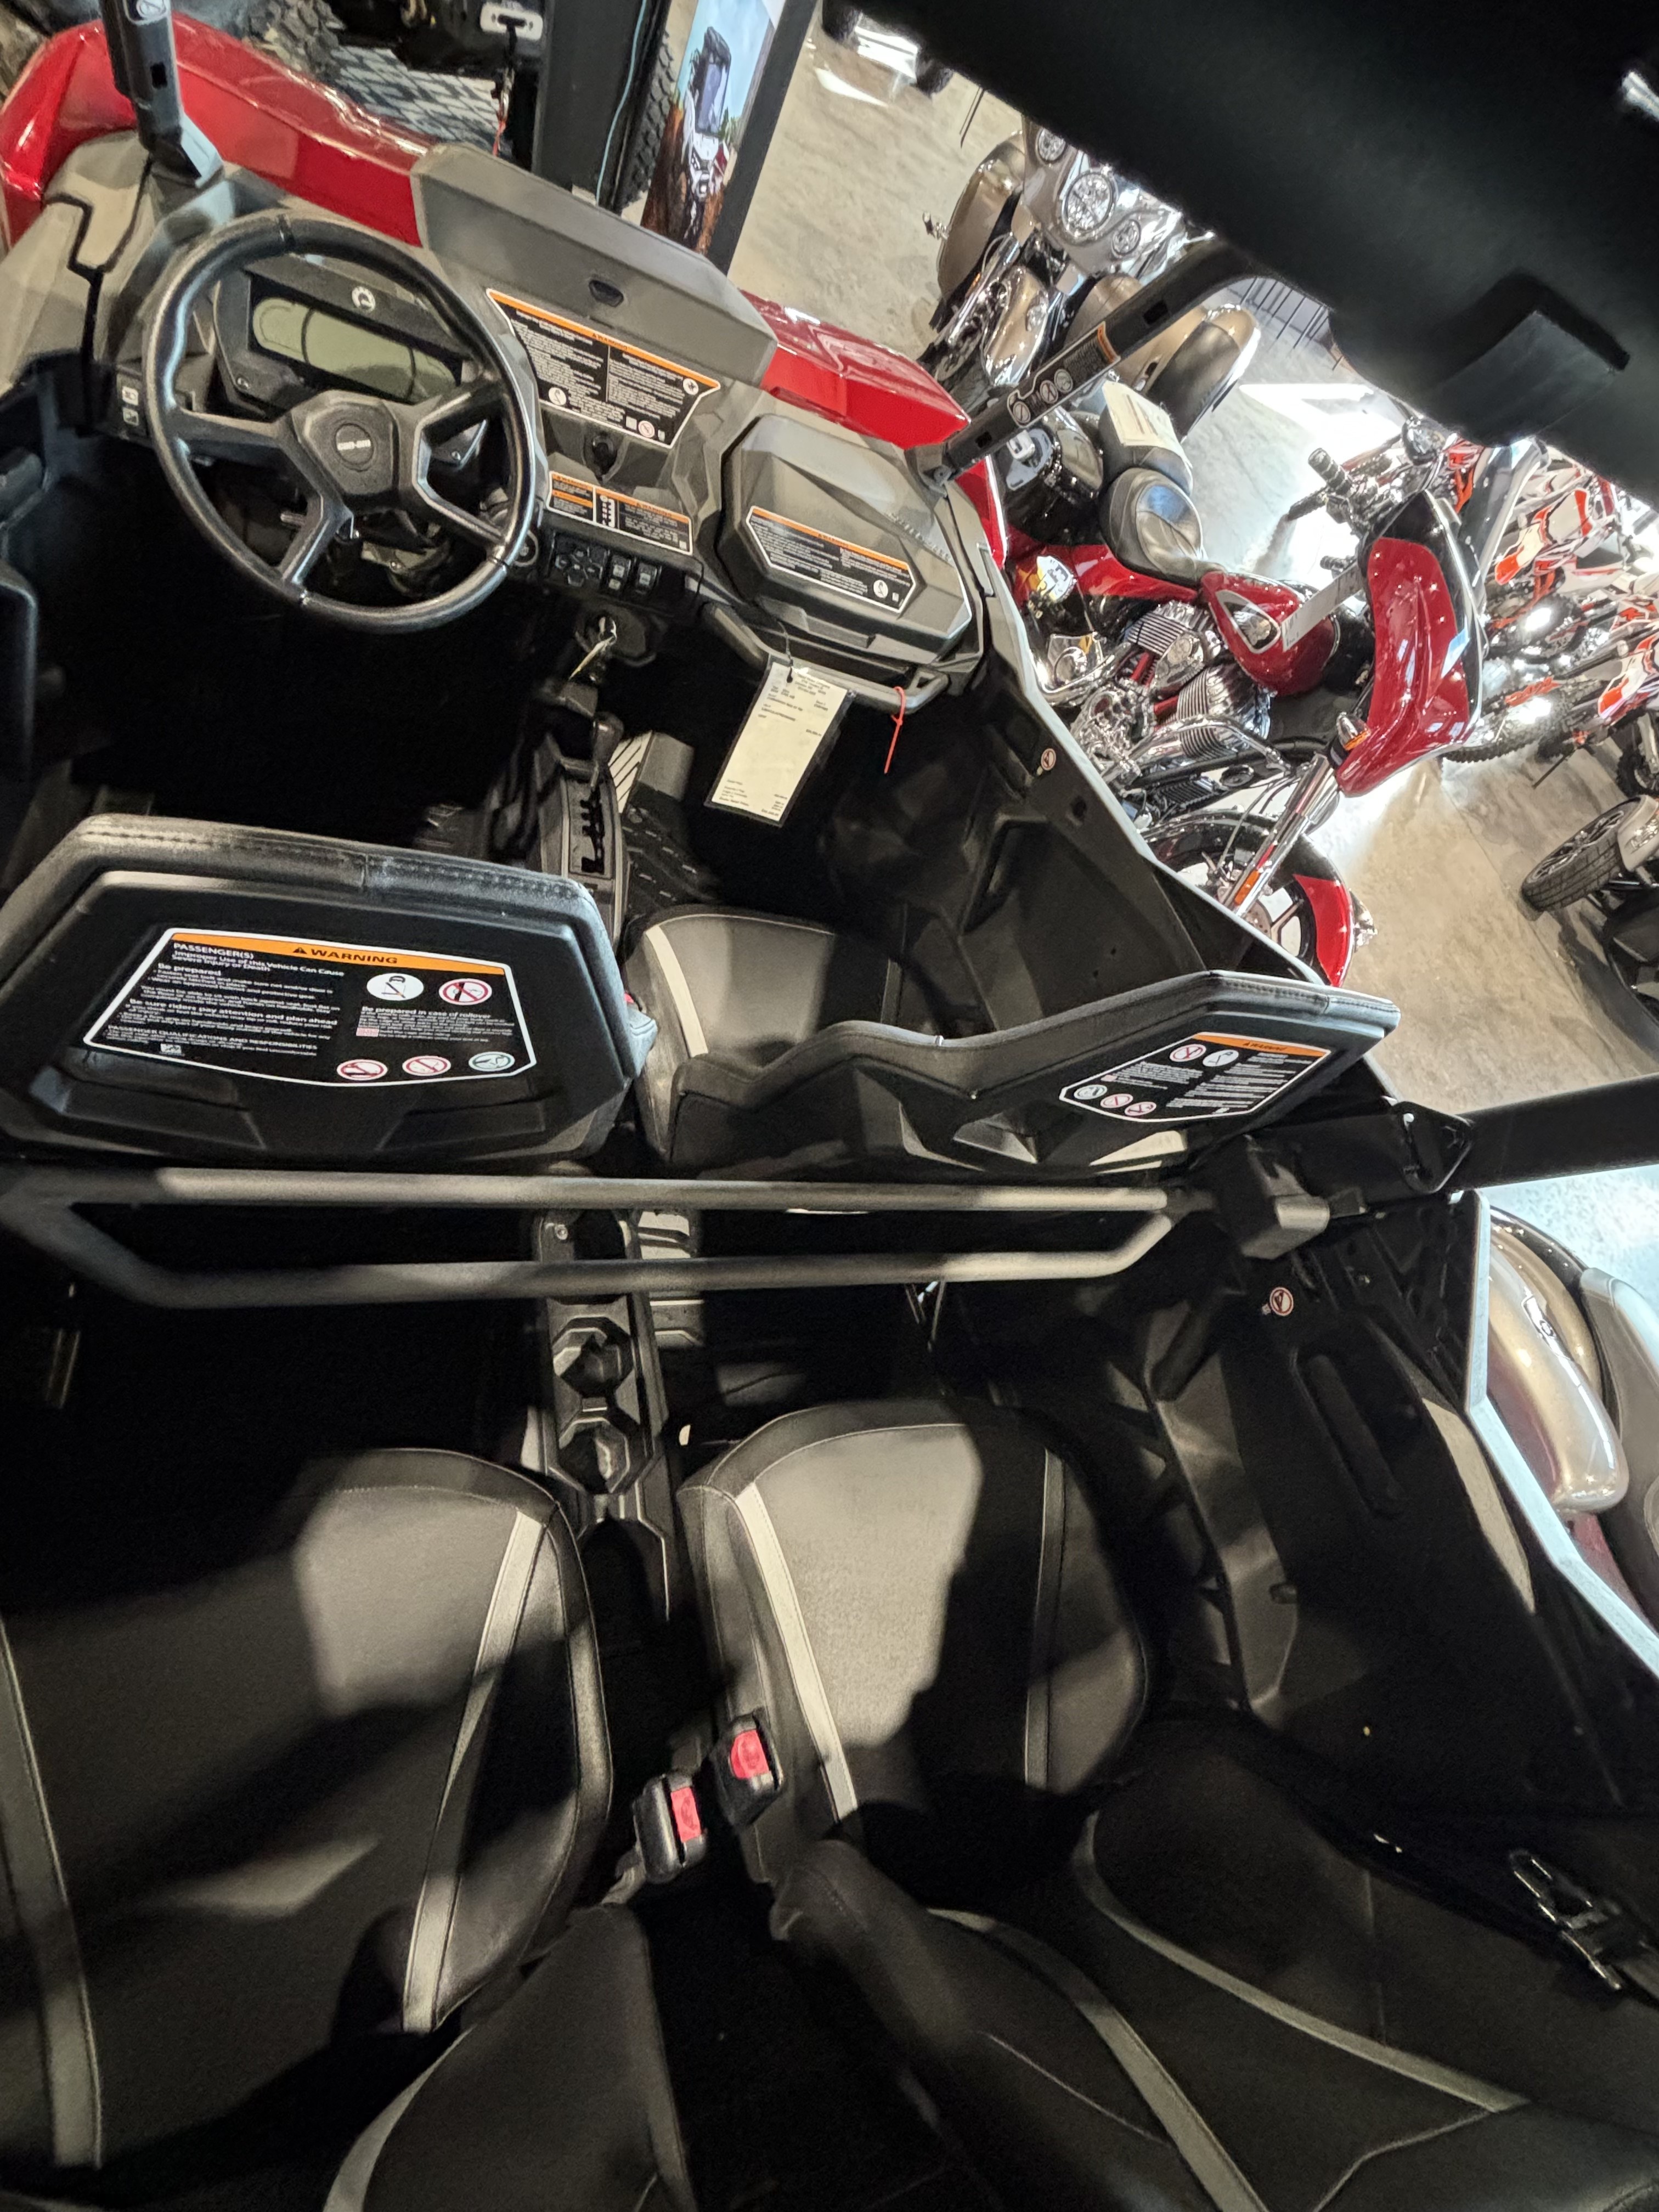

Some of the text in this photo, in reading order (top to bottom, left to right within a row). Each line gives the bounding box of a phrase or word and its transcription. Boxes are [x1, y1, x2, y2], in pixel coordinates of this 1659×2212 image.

[173, 943, 255, 960] PASSENGER(S)
[311, 949, 398, 964] WARNING
[172, 955, 202, 963] Severe
[204, 959, 230, 967] Injury
[174, 950, 217, 961] Improper
[266, 962, 298, 971] Vehicle
[173, 966, 221, 976] prepared
[199, 1007, 217, 1015] pay
[219, 1009, 263, 1018] attention
[108, 1025, 157, 1034] PASSENGER
[159, 1030, 228, 1041] QUALIFICATIONS
[249, 1039, 318, 1049] RESPONSIBILITIES
